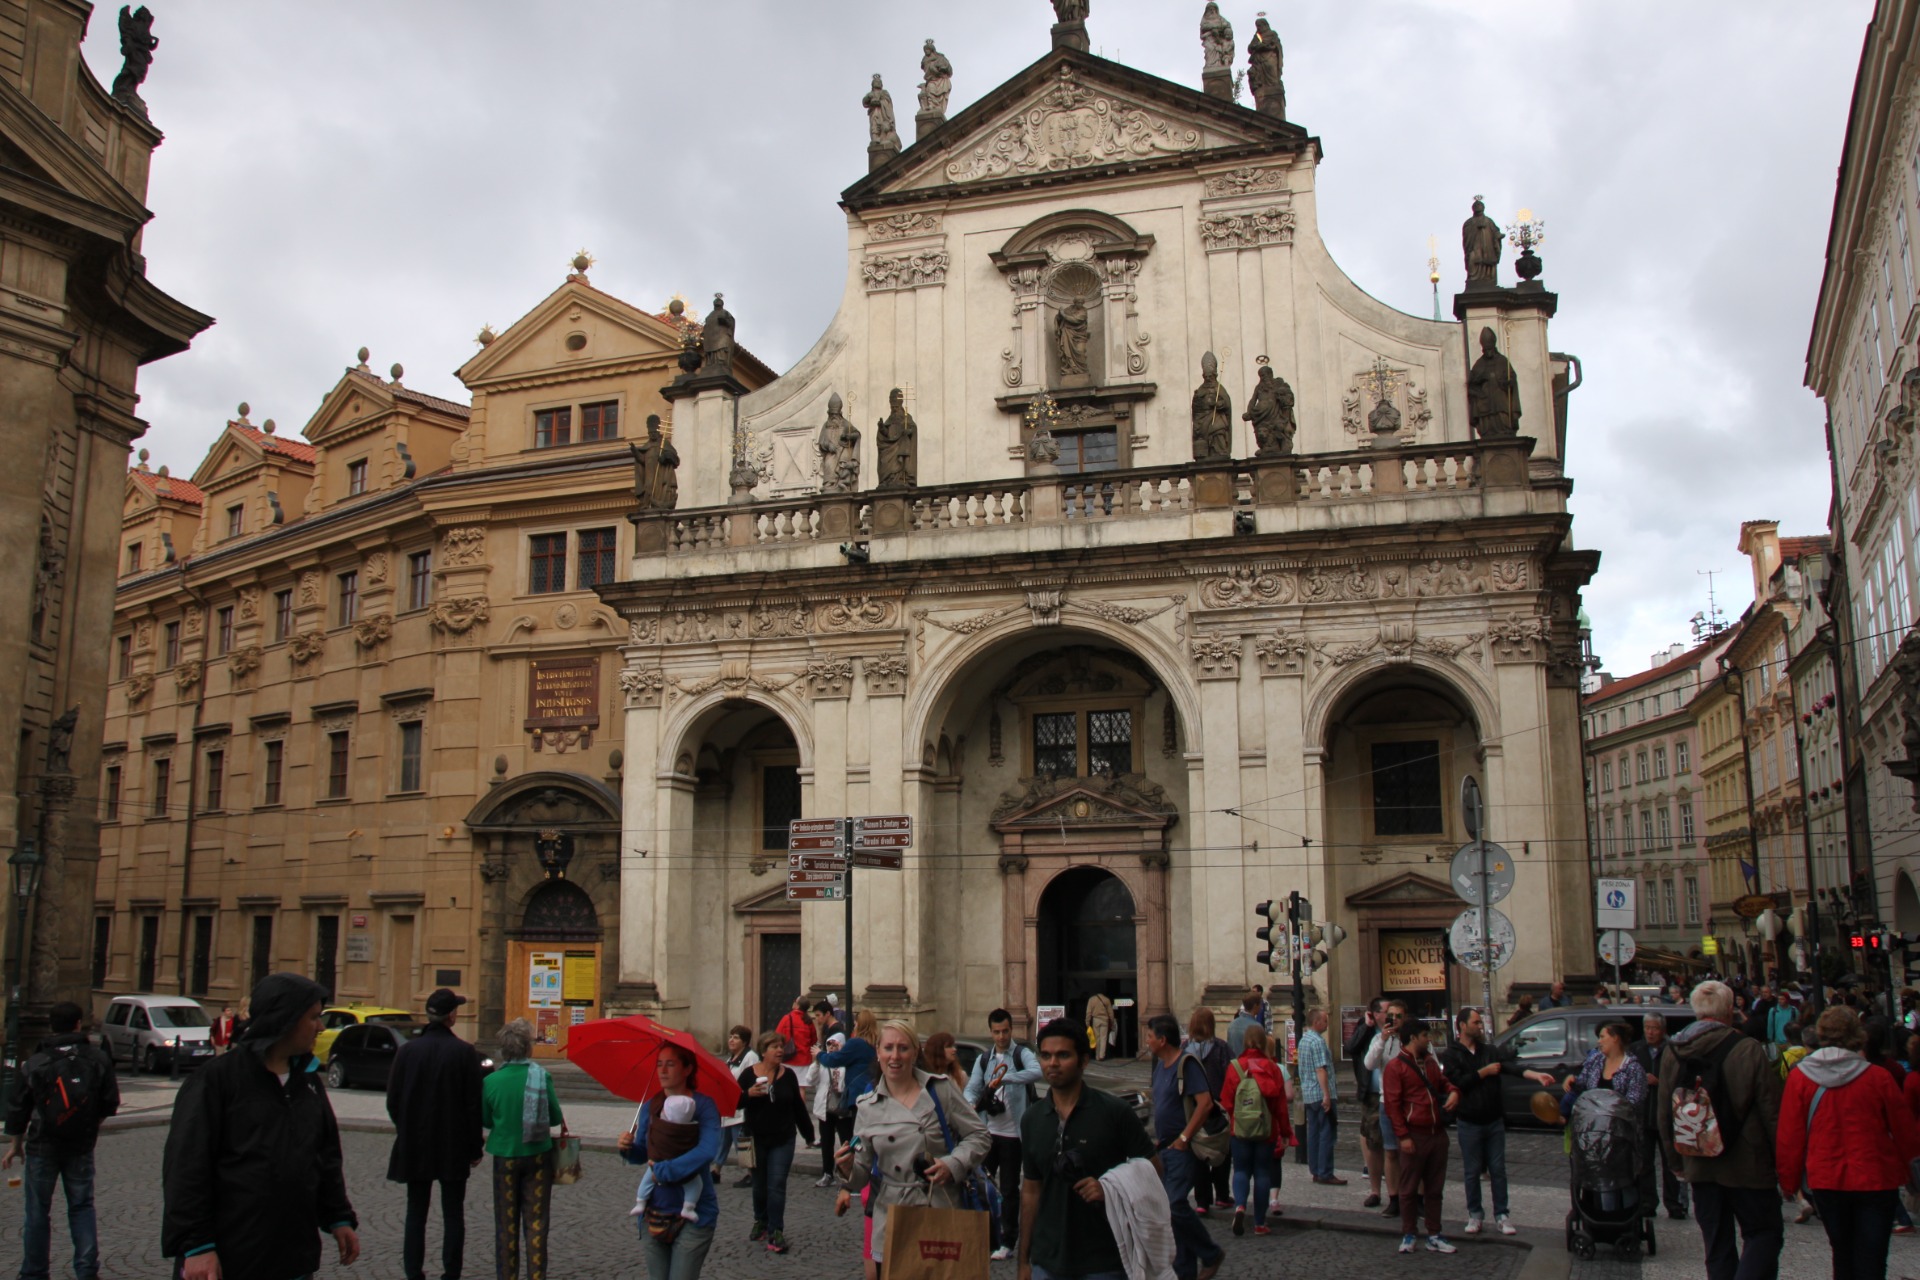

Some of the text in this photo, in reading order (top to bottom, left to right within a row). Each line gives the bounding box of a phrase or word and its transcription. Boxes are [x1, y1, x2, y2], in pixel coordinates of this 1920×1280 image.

[825, 888, 832, 897] A
[1851, 936, 1864, 947] 33
[1388, 948, 1445, 965] CONCER
[1388, 967, 1420, 976] Mozart
[1389, 975, 1445, 986] Vivaldi Bach
